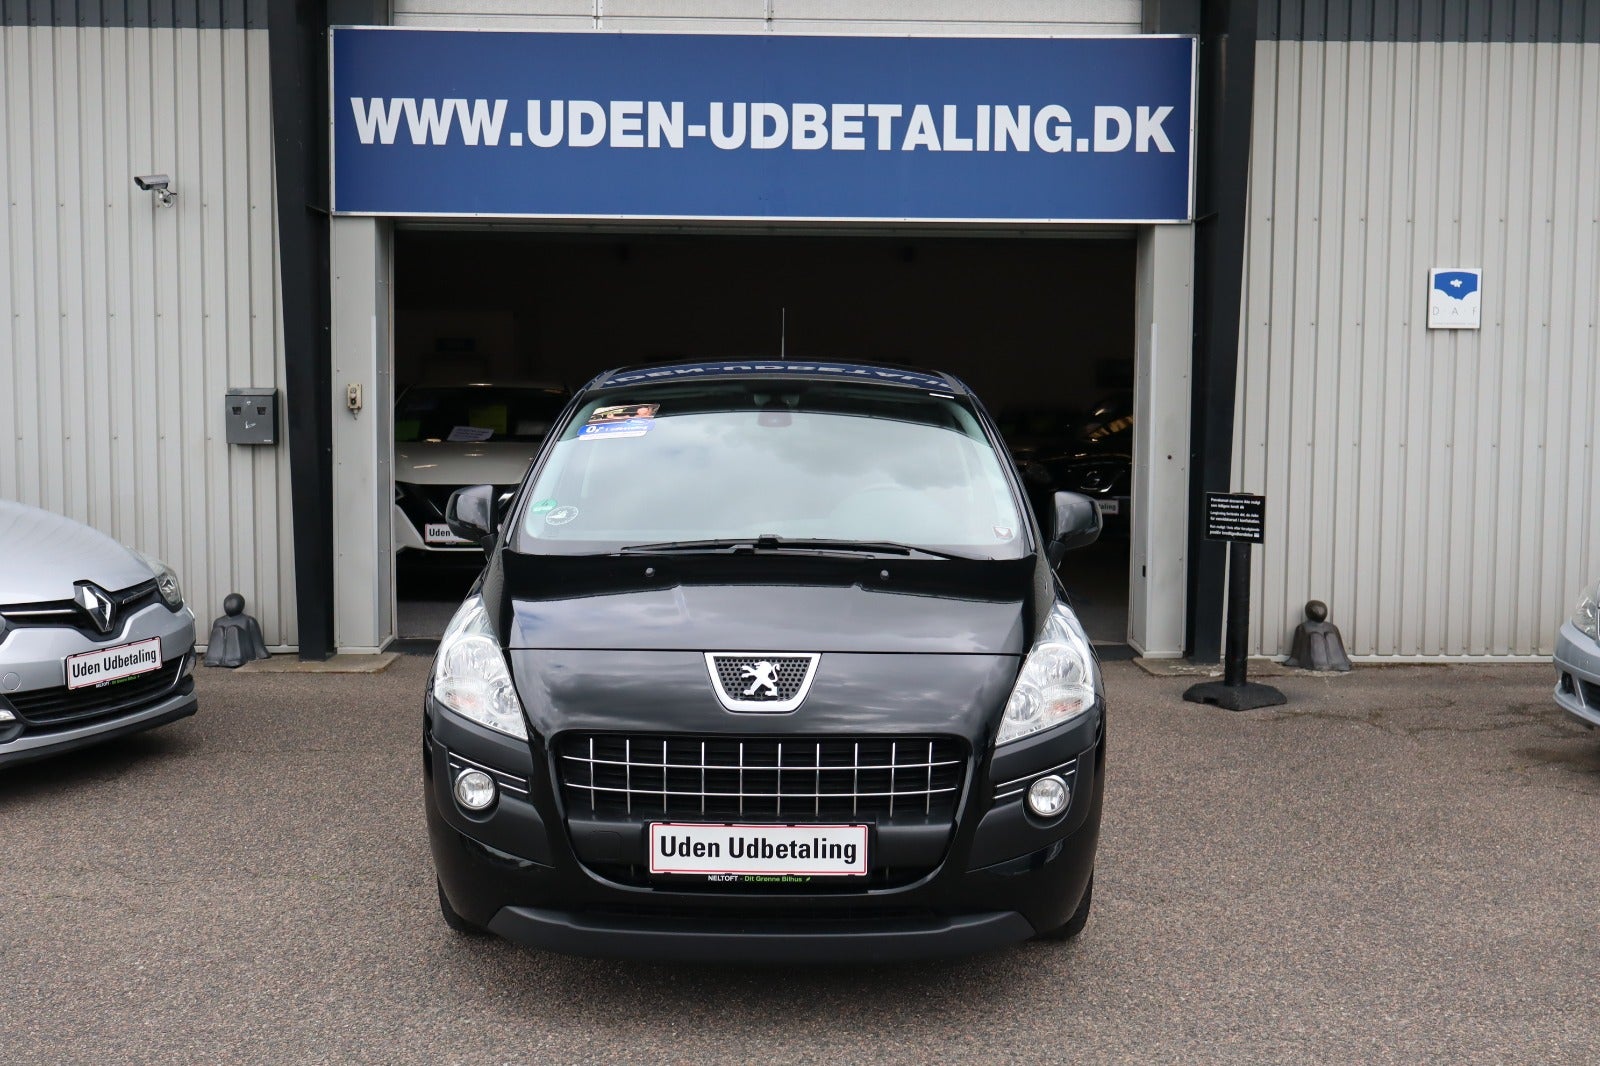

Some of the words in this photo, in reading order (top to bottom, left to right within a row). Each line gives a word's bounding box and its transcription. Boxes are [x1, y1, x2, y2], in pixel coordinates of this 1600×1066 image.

[350, 97, 1176, 153] WWW.UDEN-UDBETALING.DK
[429, 528, 451, 537] Uden
[72, 661, 100, 678] Uden
[103, 649, 157, 671] Udbetaling
[660, 835, 721, 858] Uden
[728, 837, 858, 865] Udbetaling
